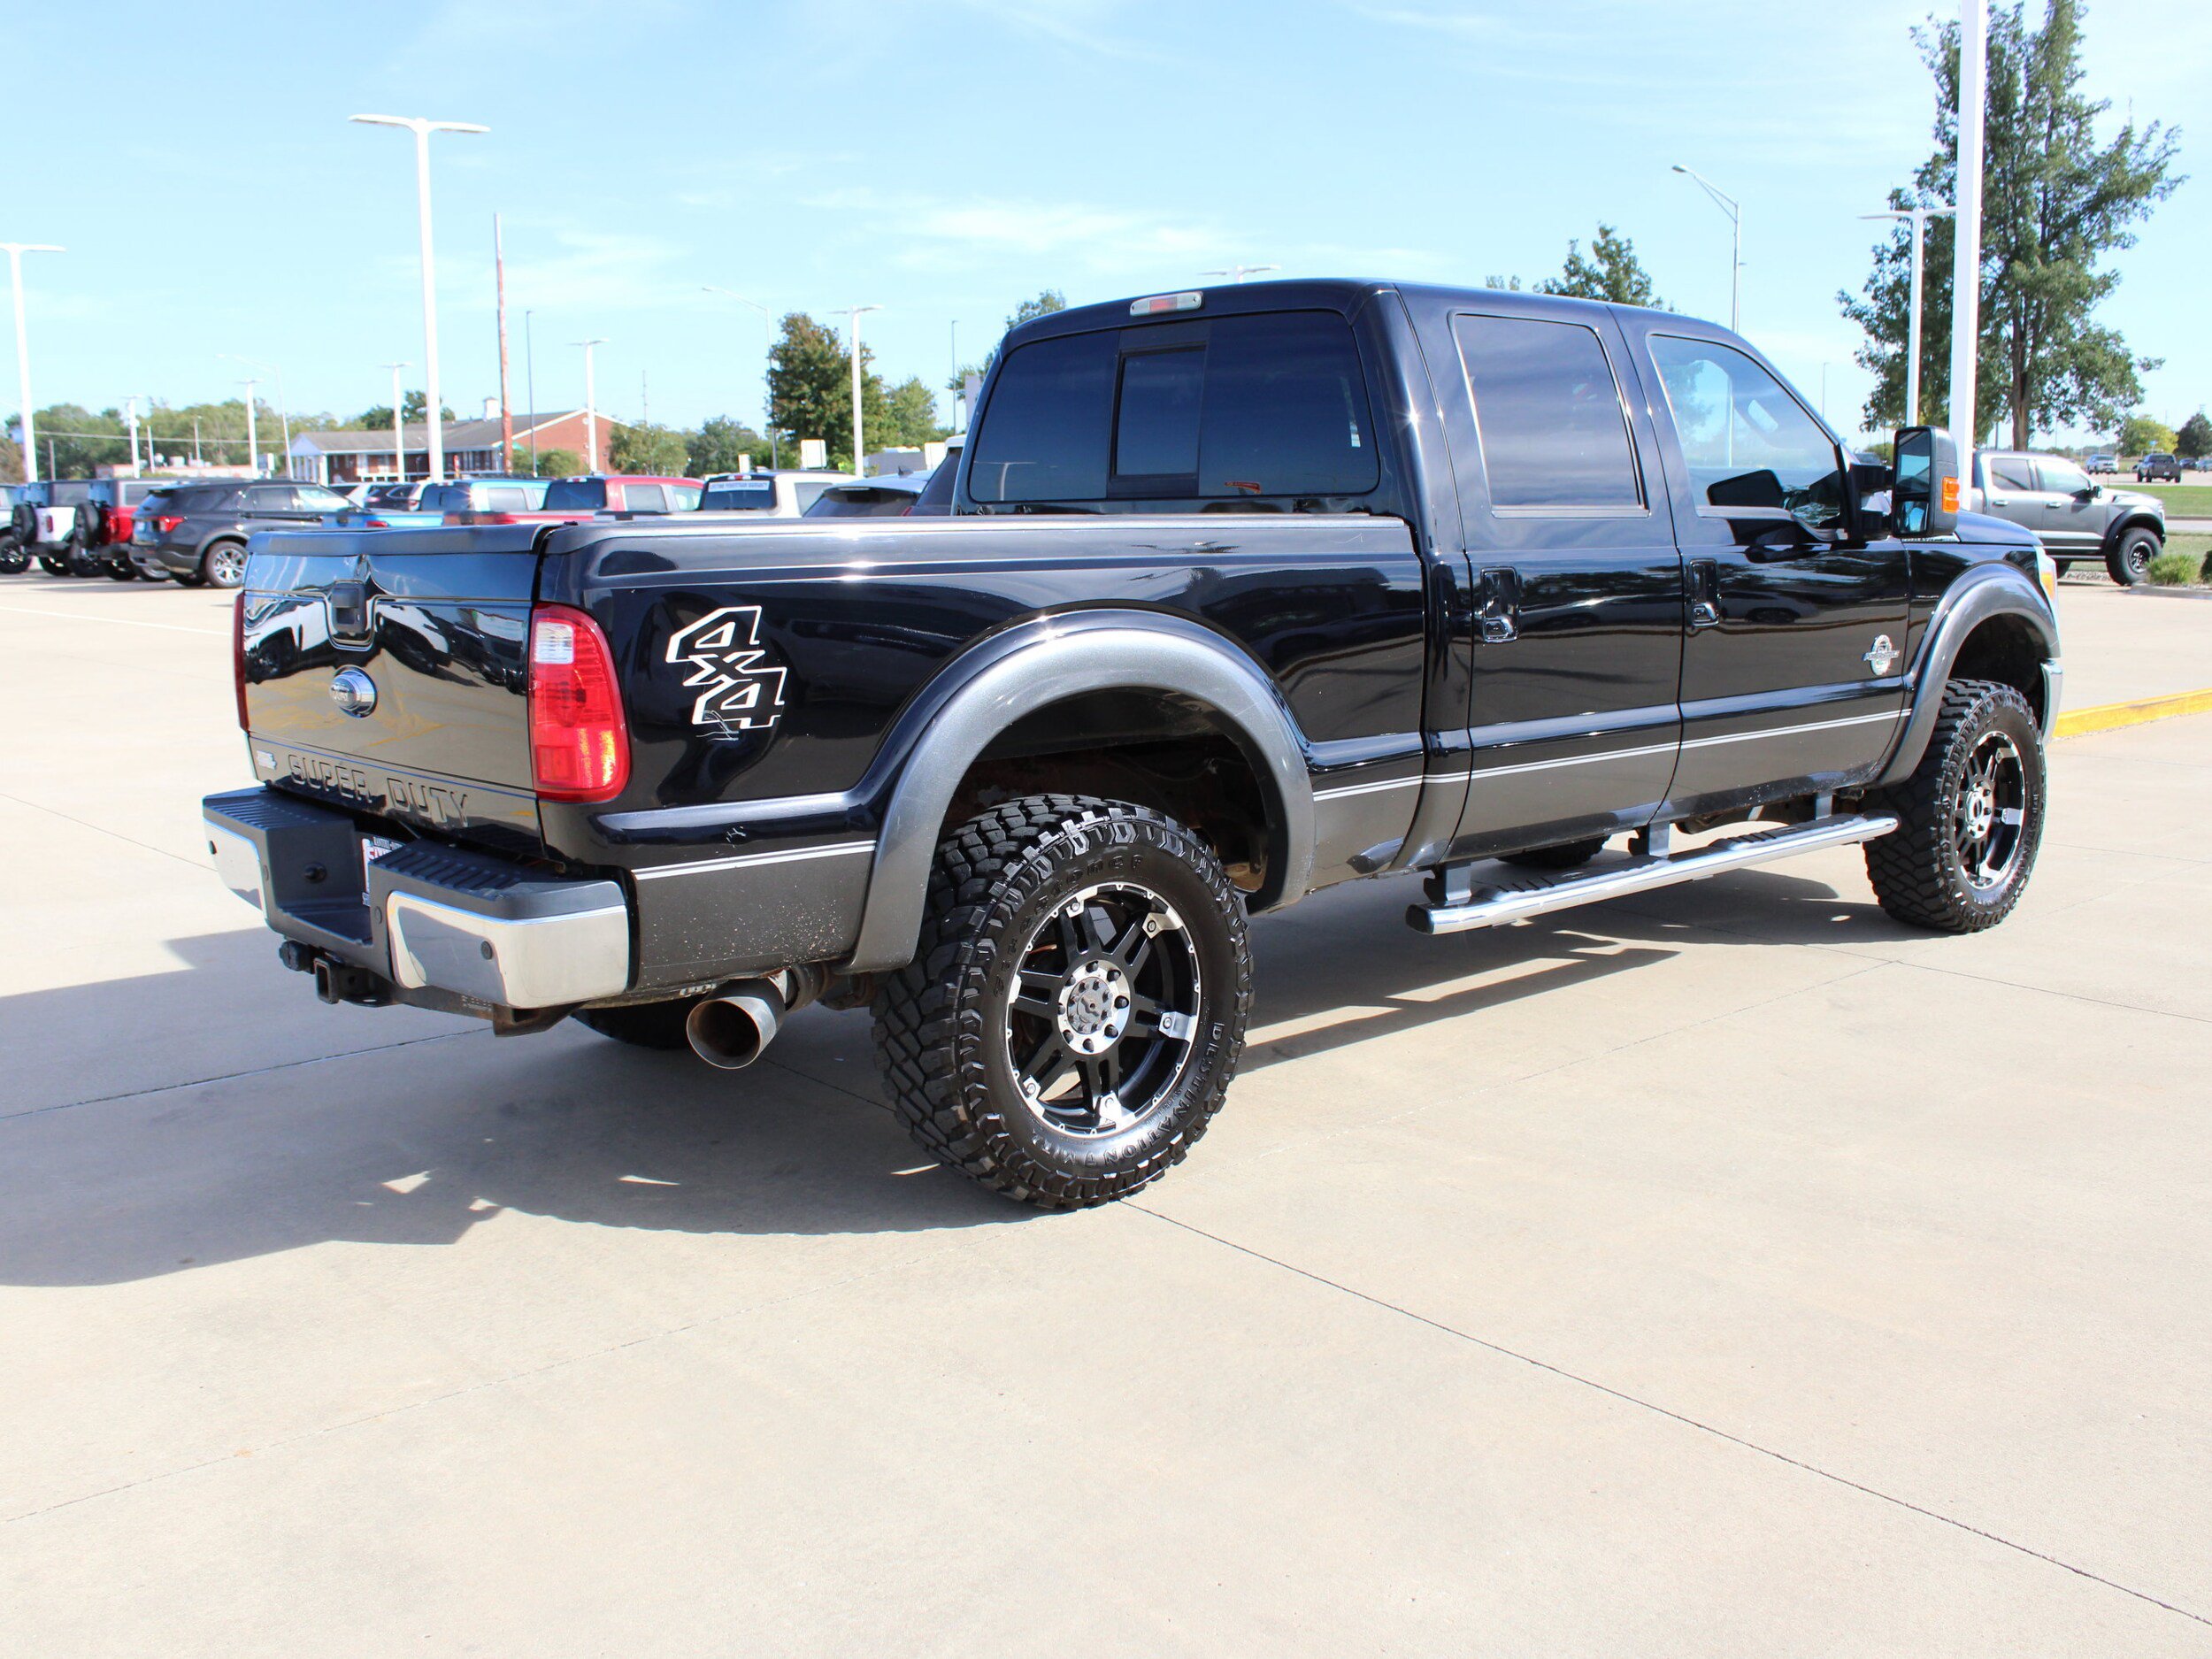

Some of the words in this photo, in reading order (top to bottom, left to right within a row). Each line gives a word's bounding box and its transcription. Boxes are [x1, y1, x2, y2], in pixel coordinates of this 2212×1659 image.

[288, 754, 373, 803] SUPER
[387, 778, 468, 828] DUTY
[1103, 1022, 1225, 1165] DESTINATION
